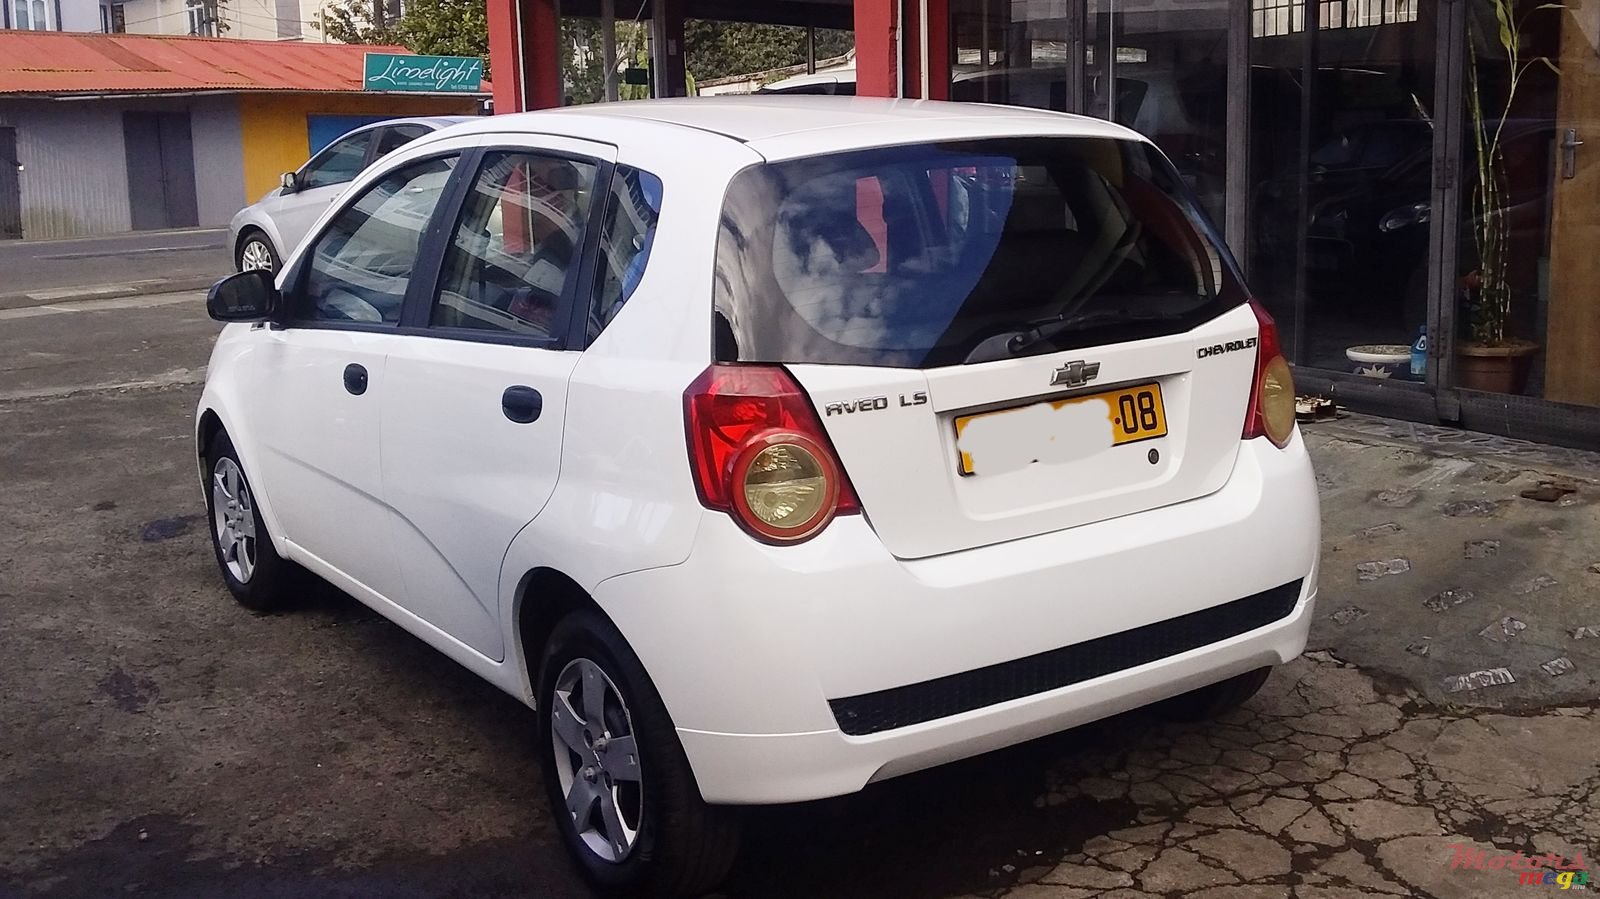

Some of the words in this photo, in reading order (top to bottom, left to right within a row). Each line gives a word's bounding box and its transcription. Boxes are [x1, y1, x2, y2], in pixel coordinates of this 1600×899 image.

[368, 57, 480, 90] Limelight
[1196, 337, 1257, 359] CHEVROLET
[825, 396, 888, 416] AVEO
[899, 392, 928, 407] LS
